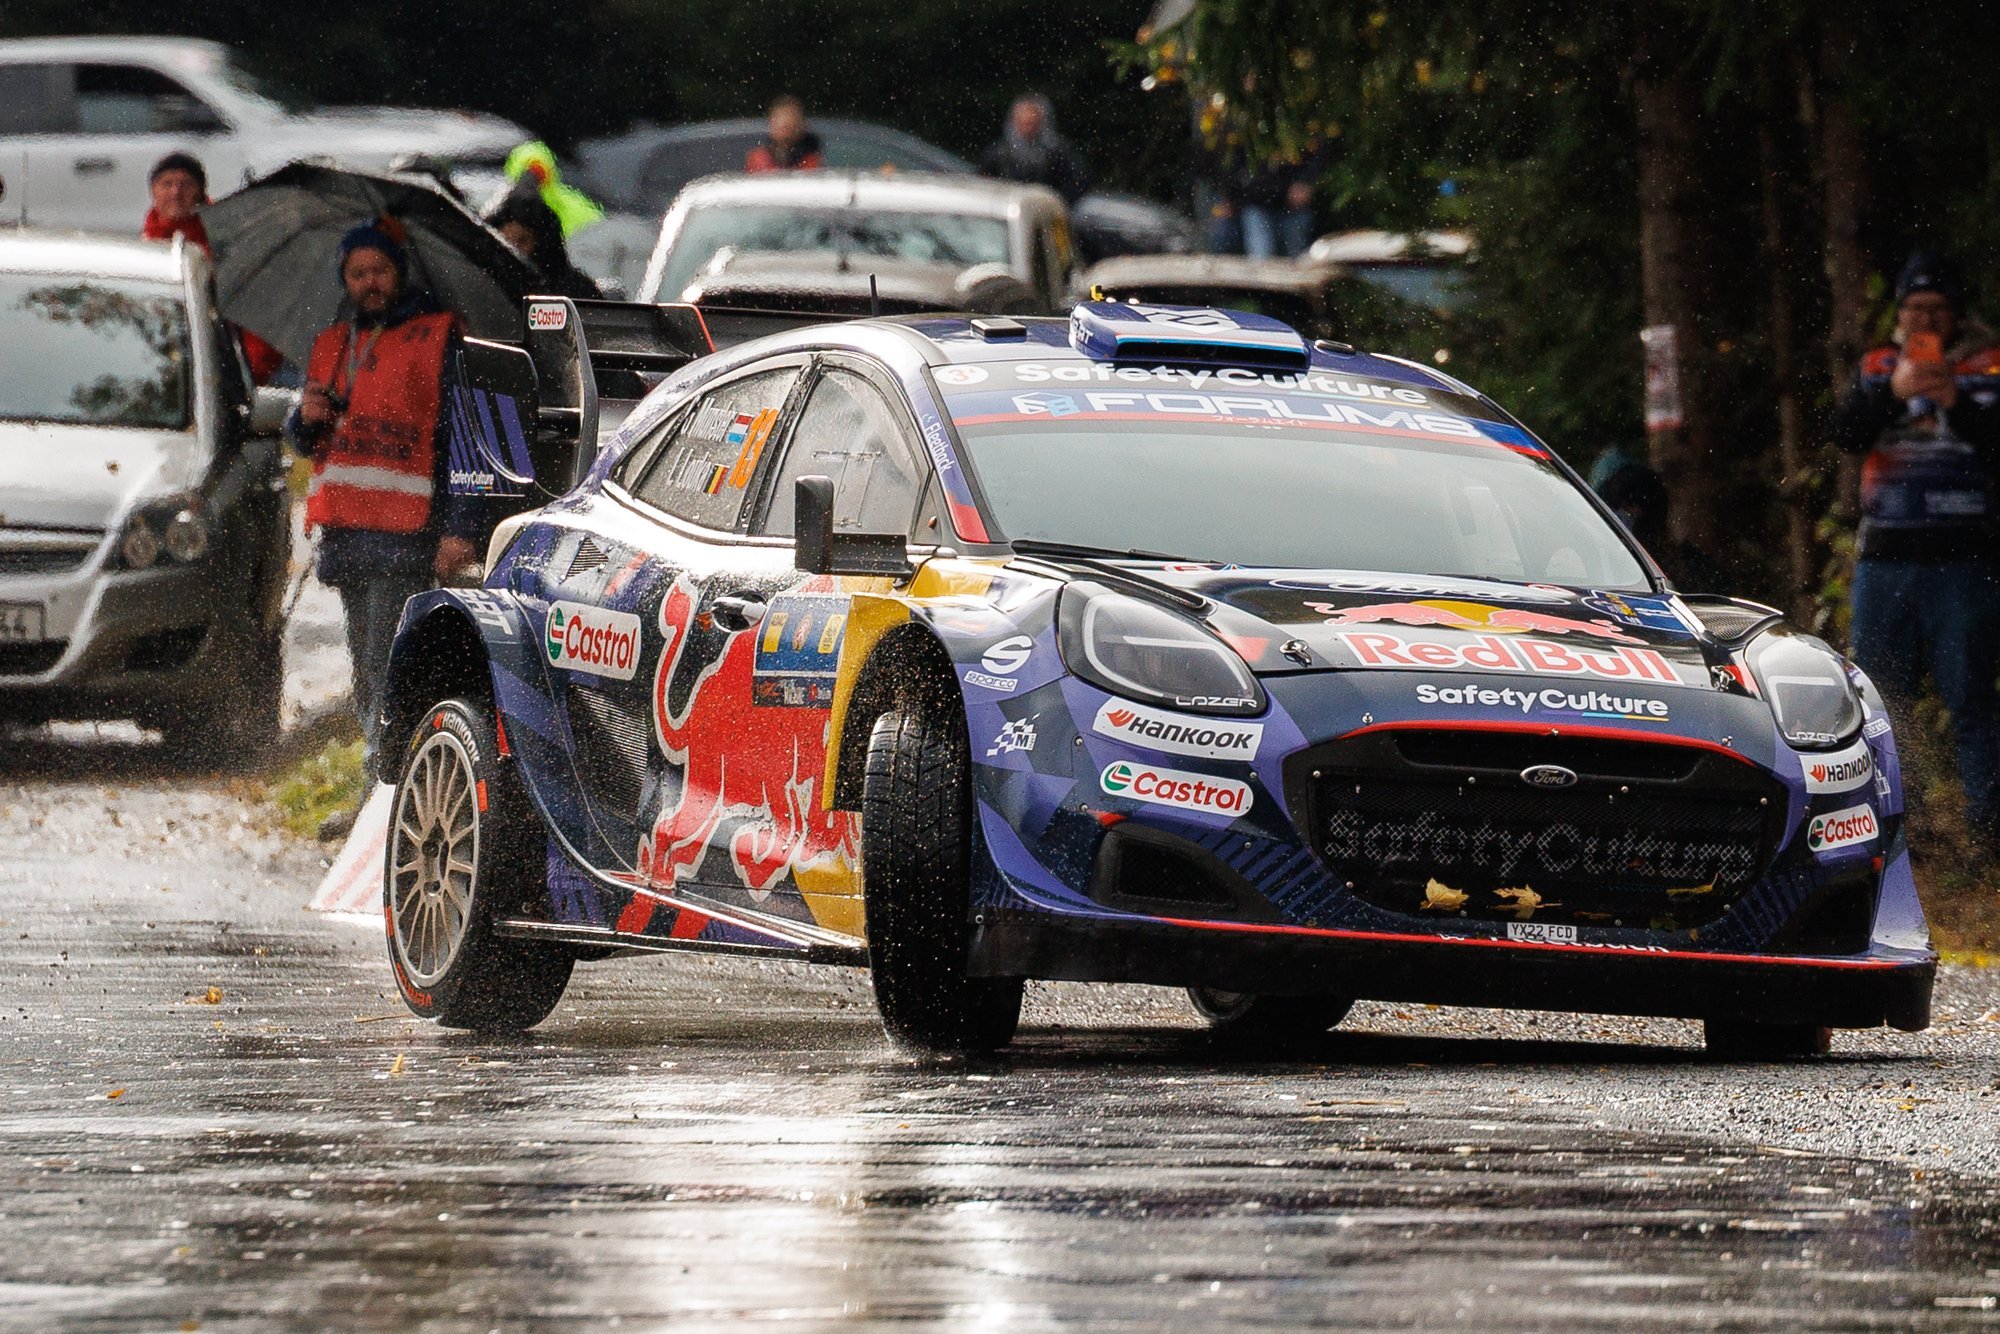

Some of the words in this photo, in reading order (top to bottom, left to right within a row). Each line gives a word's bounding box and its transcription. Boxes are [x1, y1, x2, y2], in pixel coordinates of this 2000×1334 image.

[537, 308, 565, 326] Castrol
[1015, 363, 1428, 405] SafetyCulture
[1085, 392, 1481, 438] FORUM8
[728, 407, 779, 489] 13
[924, 421, 956, 475] Fleetback
[450, 469, 495, 489] SafetyCulture
[565, 614, 638, 670] Castrol
[1341, 632, 1521, 670] Red
[1512, 637, 1682, 684] Bull
[968, 672, 1016, 689] sparco
[1176, 696, 1258, 708] LAZER
[1416, 684, 1669, 717] SafetyCulture
[1784, 731, 1839, 744] LAZER
[1134, 771, 1246, 811] Castrol
[1824, 809, 1876, 843] Castrol
[1325, 810, 1757, 884] SafetyCulture
[1511, 923, 1544, 938] YX22
[1549, 925, 1574, 939] FCD
